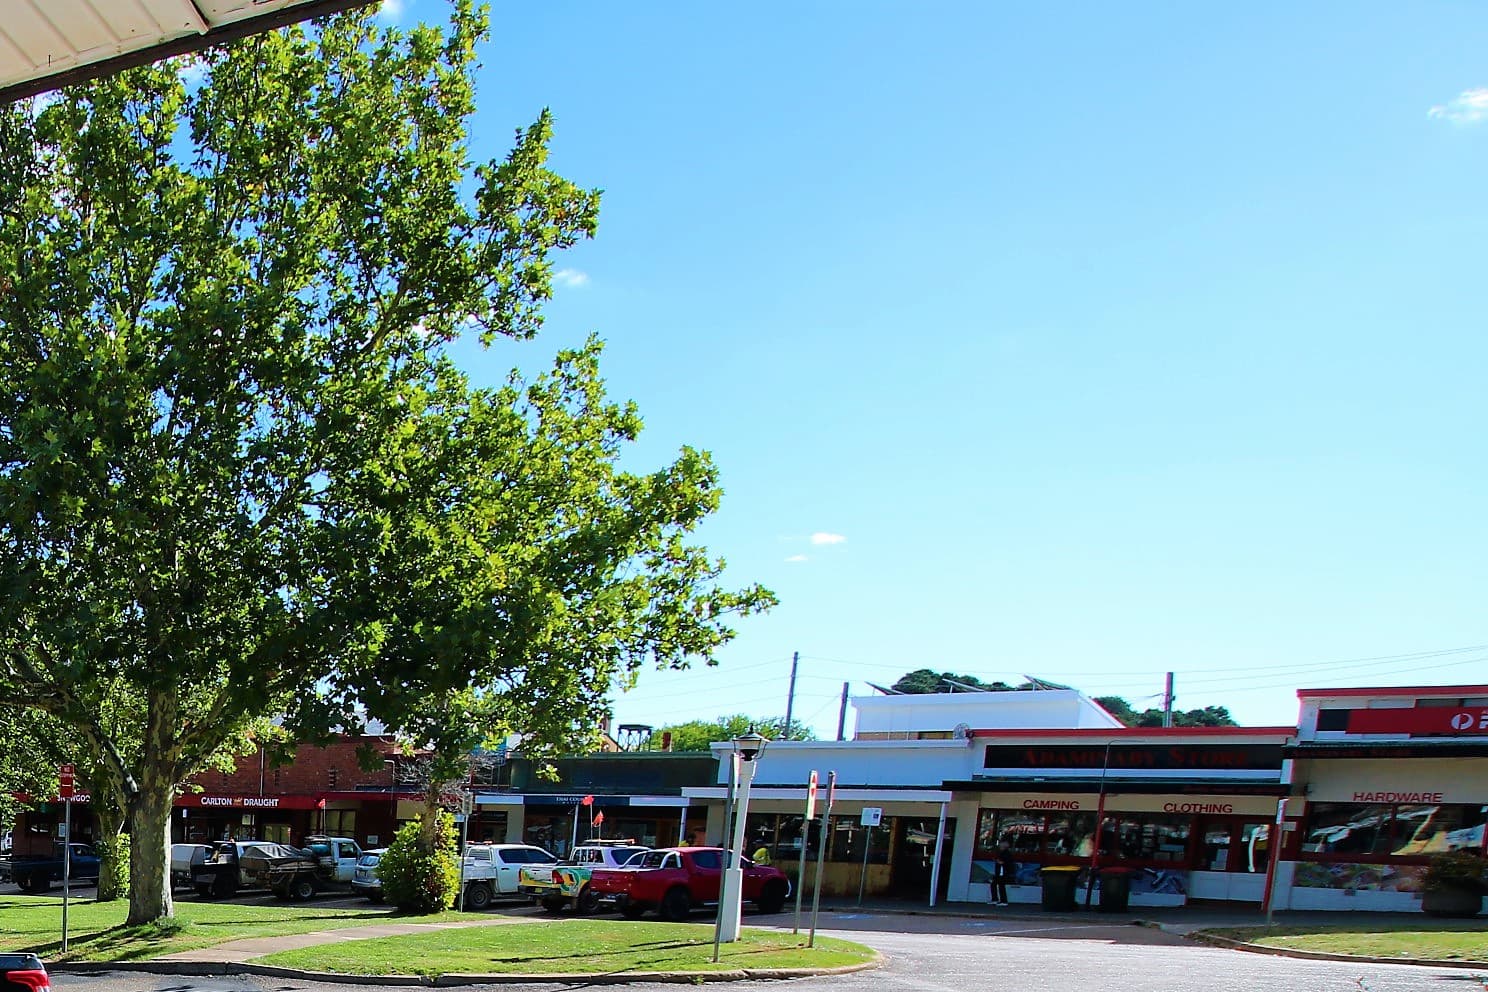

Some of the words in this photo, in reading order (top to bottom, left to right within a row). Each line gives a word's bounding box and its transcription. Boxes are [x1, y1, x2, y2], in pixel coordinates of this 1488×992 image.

[201, 796, 233, 806] CARLTON
[243, 798, 280, 808] DRAUGHT
[1353, 791, 1444, 803] HARDWARE
[1023, 799, 1080, 811] CAMPING
[1163, 802, 1233, 815] CLOTHING
